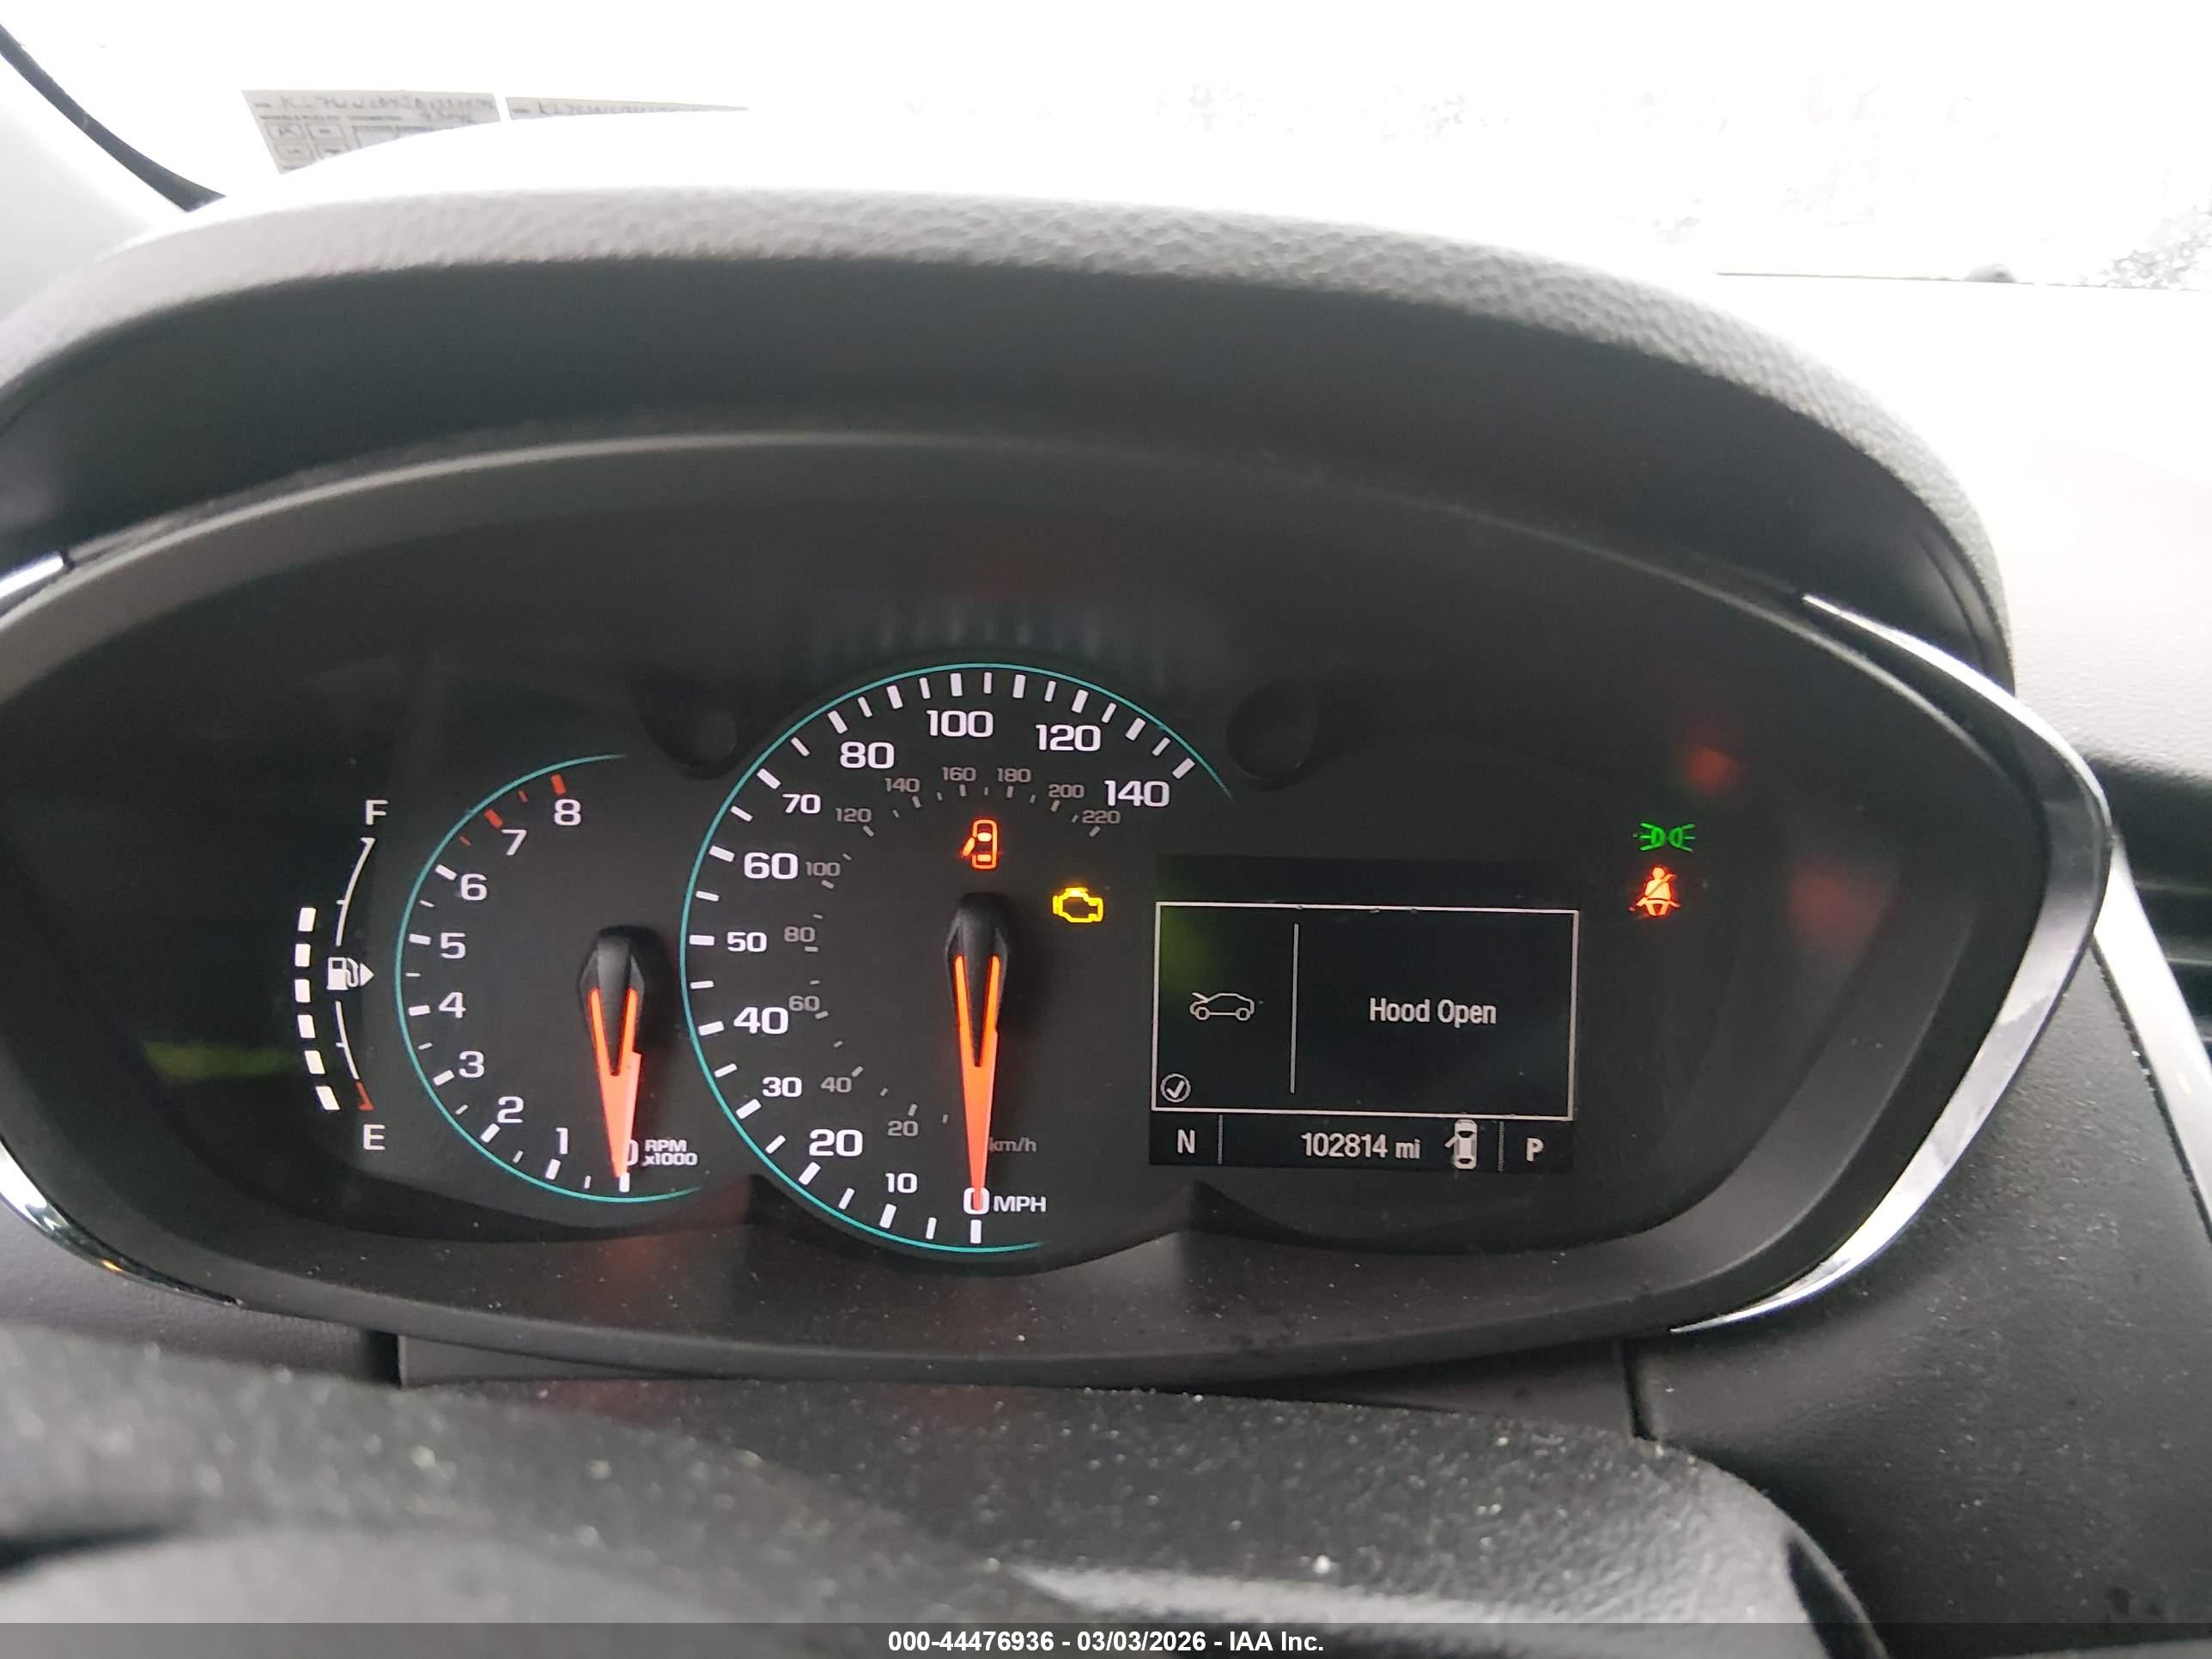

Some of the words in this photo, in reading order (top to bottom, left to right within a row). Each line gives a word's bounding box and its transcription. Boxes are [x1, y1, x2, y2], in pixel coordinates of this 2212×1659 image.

[926, 709, 994, 738] 100
[1035, 723, 1102, 751] 120
[840, 741, 895, 769] 80
[884, 777, 921, 793] 140
[942, 766, 976, 781] 160
[997, 768, 1031, 783] 180
[782, 793, 821, 814] 70
[1048, 783, 1085, 799] 200
[1104, 780, 1170, 807] 140
[365, 799, 388, 825] F
[554, 799, 581, 826] 8
[836, 807, 872, 824] 120
[1081, 810, 1121, 826] 220
[501, 829, 527, 856] 7
[744, 852, 799, 880] 60
[805, 861, 841, 877] 100
[460, 873, 488, 901] 6
[441, 932, 466, 959] 5
[726, 931, 768, 952] 50
[783, 926, 816, 943] 80
[438, 992, 466, 1018] 4
[787, 995, 820, 1012] 60
[1370, 997, 1431, 1023] Hood
[1437, 999, 1497, 1029] Open
[733, 1006, 789, 1035] 40
[459, 1050, 485, 1079] 3
[762, 1076, 803, 1097] 30
[820, 1076, 853, 1093] 40
[495, 1097, 524, 1124] 2
[362, 1123, 386, 1151] E
[556, 1127, 568, 1155] 1
[887, 1120, 919, 1137] 20
[1177, 1128, 1195, 1154] N
[643, 1138, 688, 1152] RPM
[809, 1128, 864, 1157] 20
[988, 1136, 1037, 1152] km/h
[1301, 1132, 1389, 1158] 102814
[1395, 1138, 1420, 1159] mi
[1526, 1137, 1544, 1162] P
[884, 1172, 918, 1194] 10
[994, 1195, 1047, 1212] MPH
